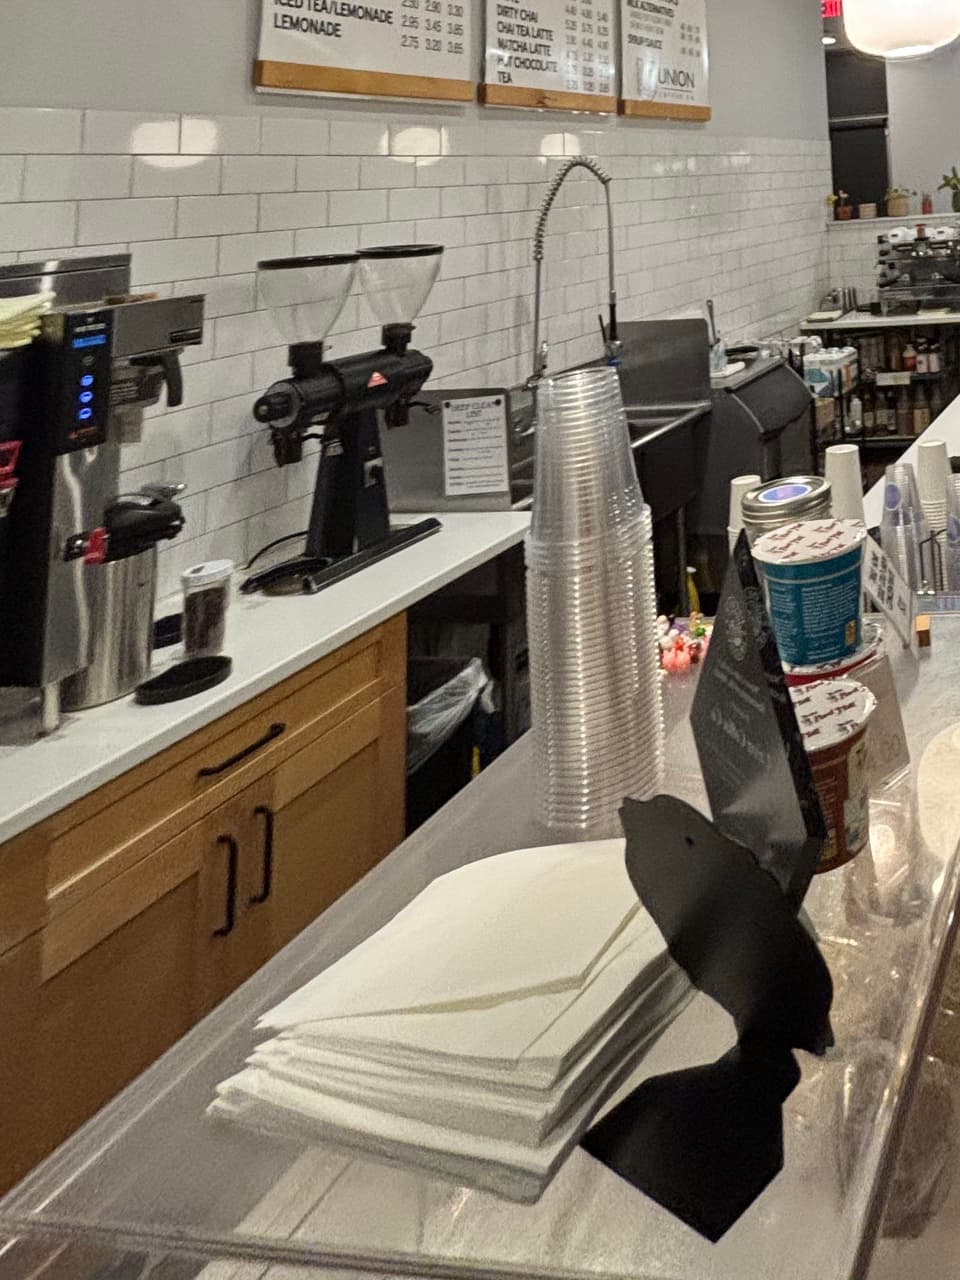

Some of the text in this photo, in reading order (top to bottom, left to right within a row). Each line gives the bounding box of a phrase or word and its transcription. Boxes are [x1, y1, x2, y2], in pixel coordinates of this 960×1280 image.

[497, 4, 538, 23] DIRTY CHAI
[274, 13, 342, 37] LEMONADE
[497, 21, 554, 41] CHAI TEA LATTE
[498, 38, 527, 53] MATCHA
[530, 42, 551, 56] LATTE
[514, 56, 558, 72] CHOCOLATE
[498, 71, 512, 84] TEA
[658, 67, 696, 88] UNION
